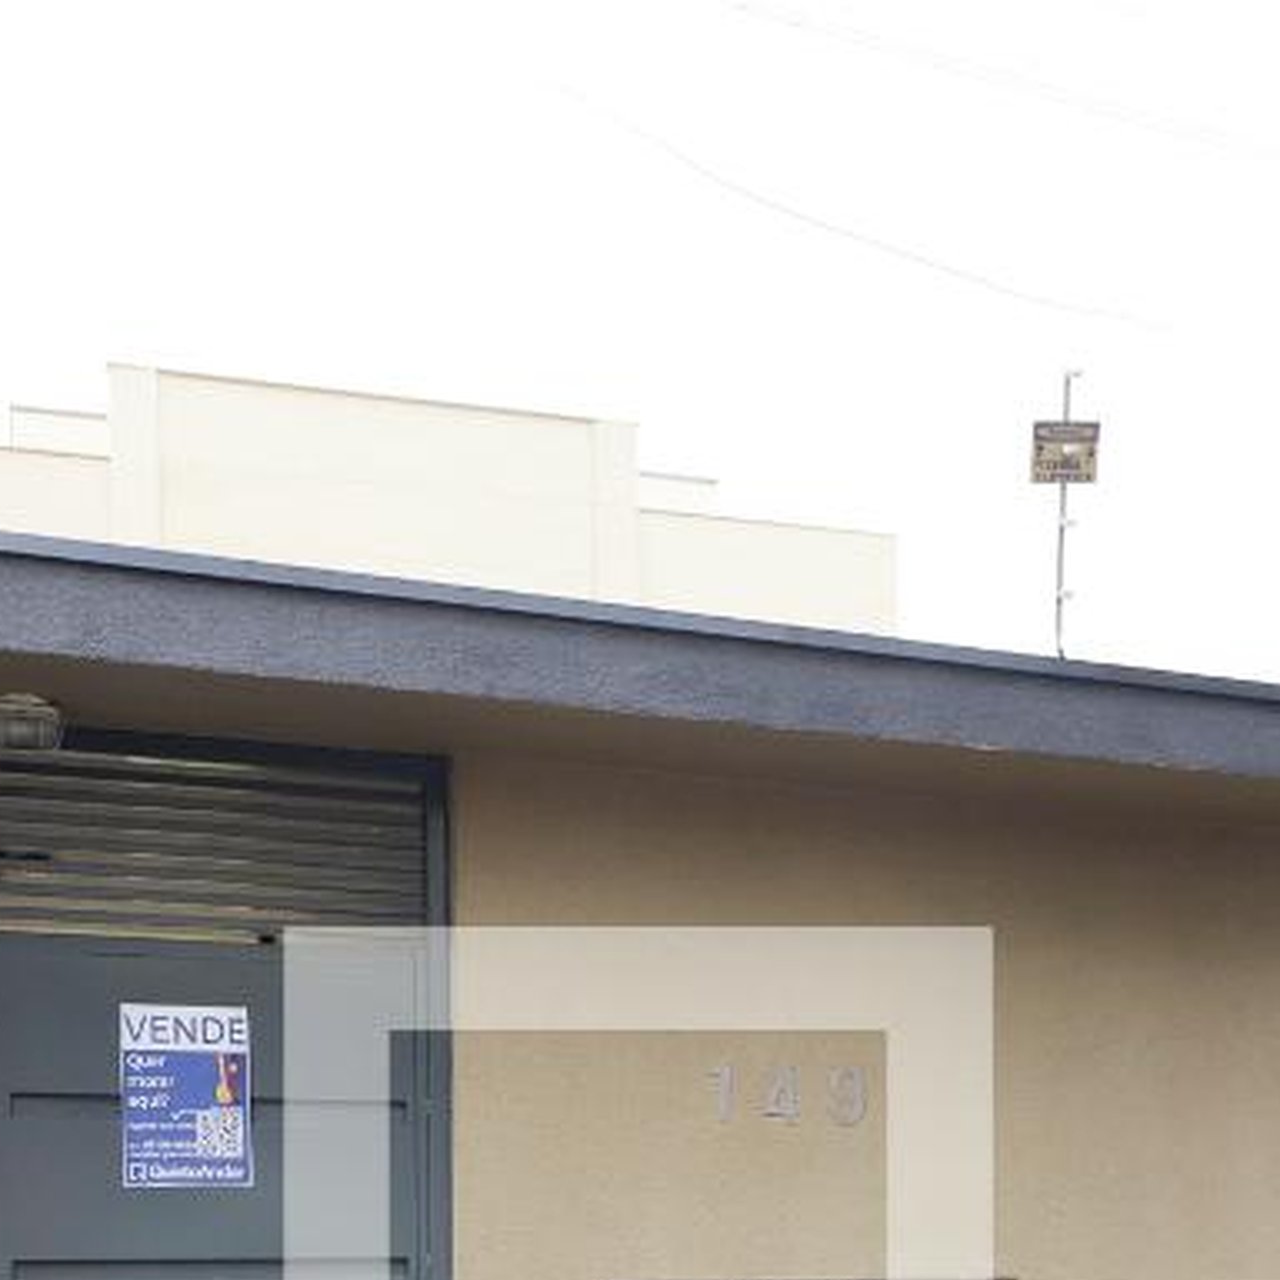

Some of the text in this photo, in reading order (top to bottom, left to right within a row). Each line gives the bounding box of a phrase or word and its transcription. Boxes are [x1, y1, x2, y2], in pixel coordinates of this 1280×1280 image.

[124, 1014, 246, 1045] VENDE
[126, 1053, 165, 1073] Quer
[705, 1065, 867, 1125] 149
